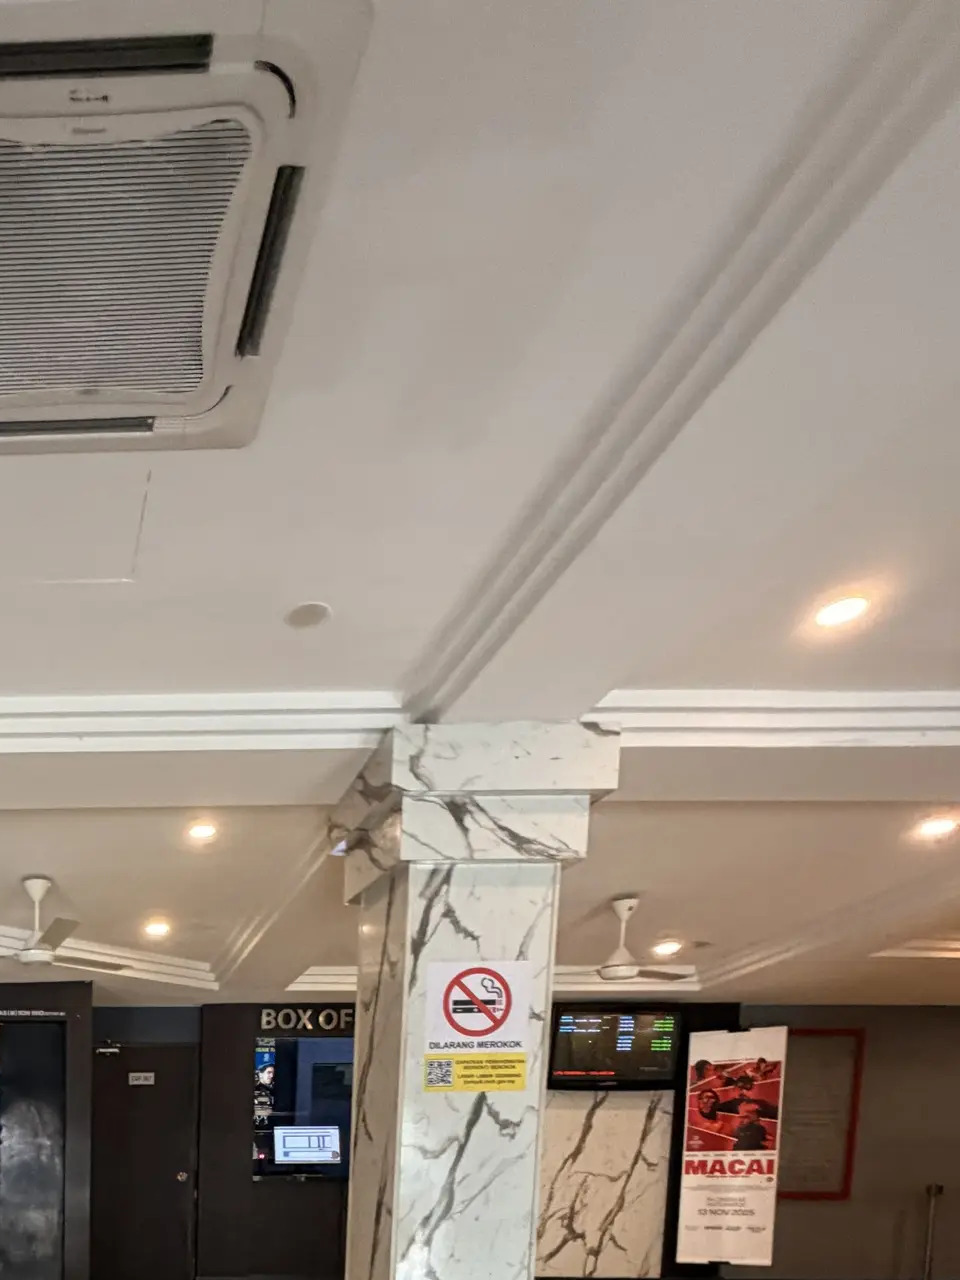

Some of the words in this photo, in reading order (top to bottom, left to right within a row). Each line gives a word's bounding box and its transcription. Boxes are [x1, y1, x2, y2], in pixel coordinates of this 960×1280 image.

[261, 1008, 313, 1030] BOX
[429, 1041, 475, 1050] DILARANG
[476, 1040, 523, 1049] MEROKOK
[684, 1158, 775, 1176] MACAI
